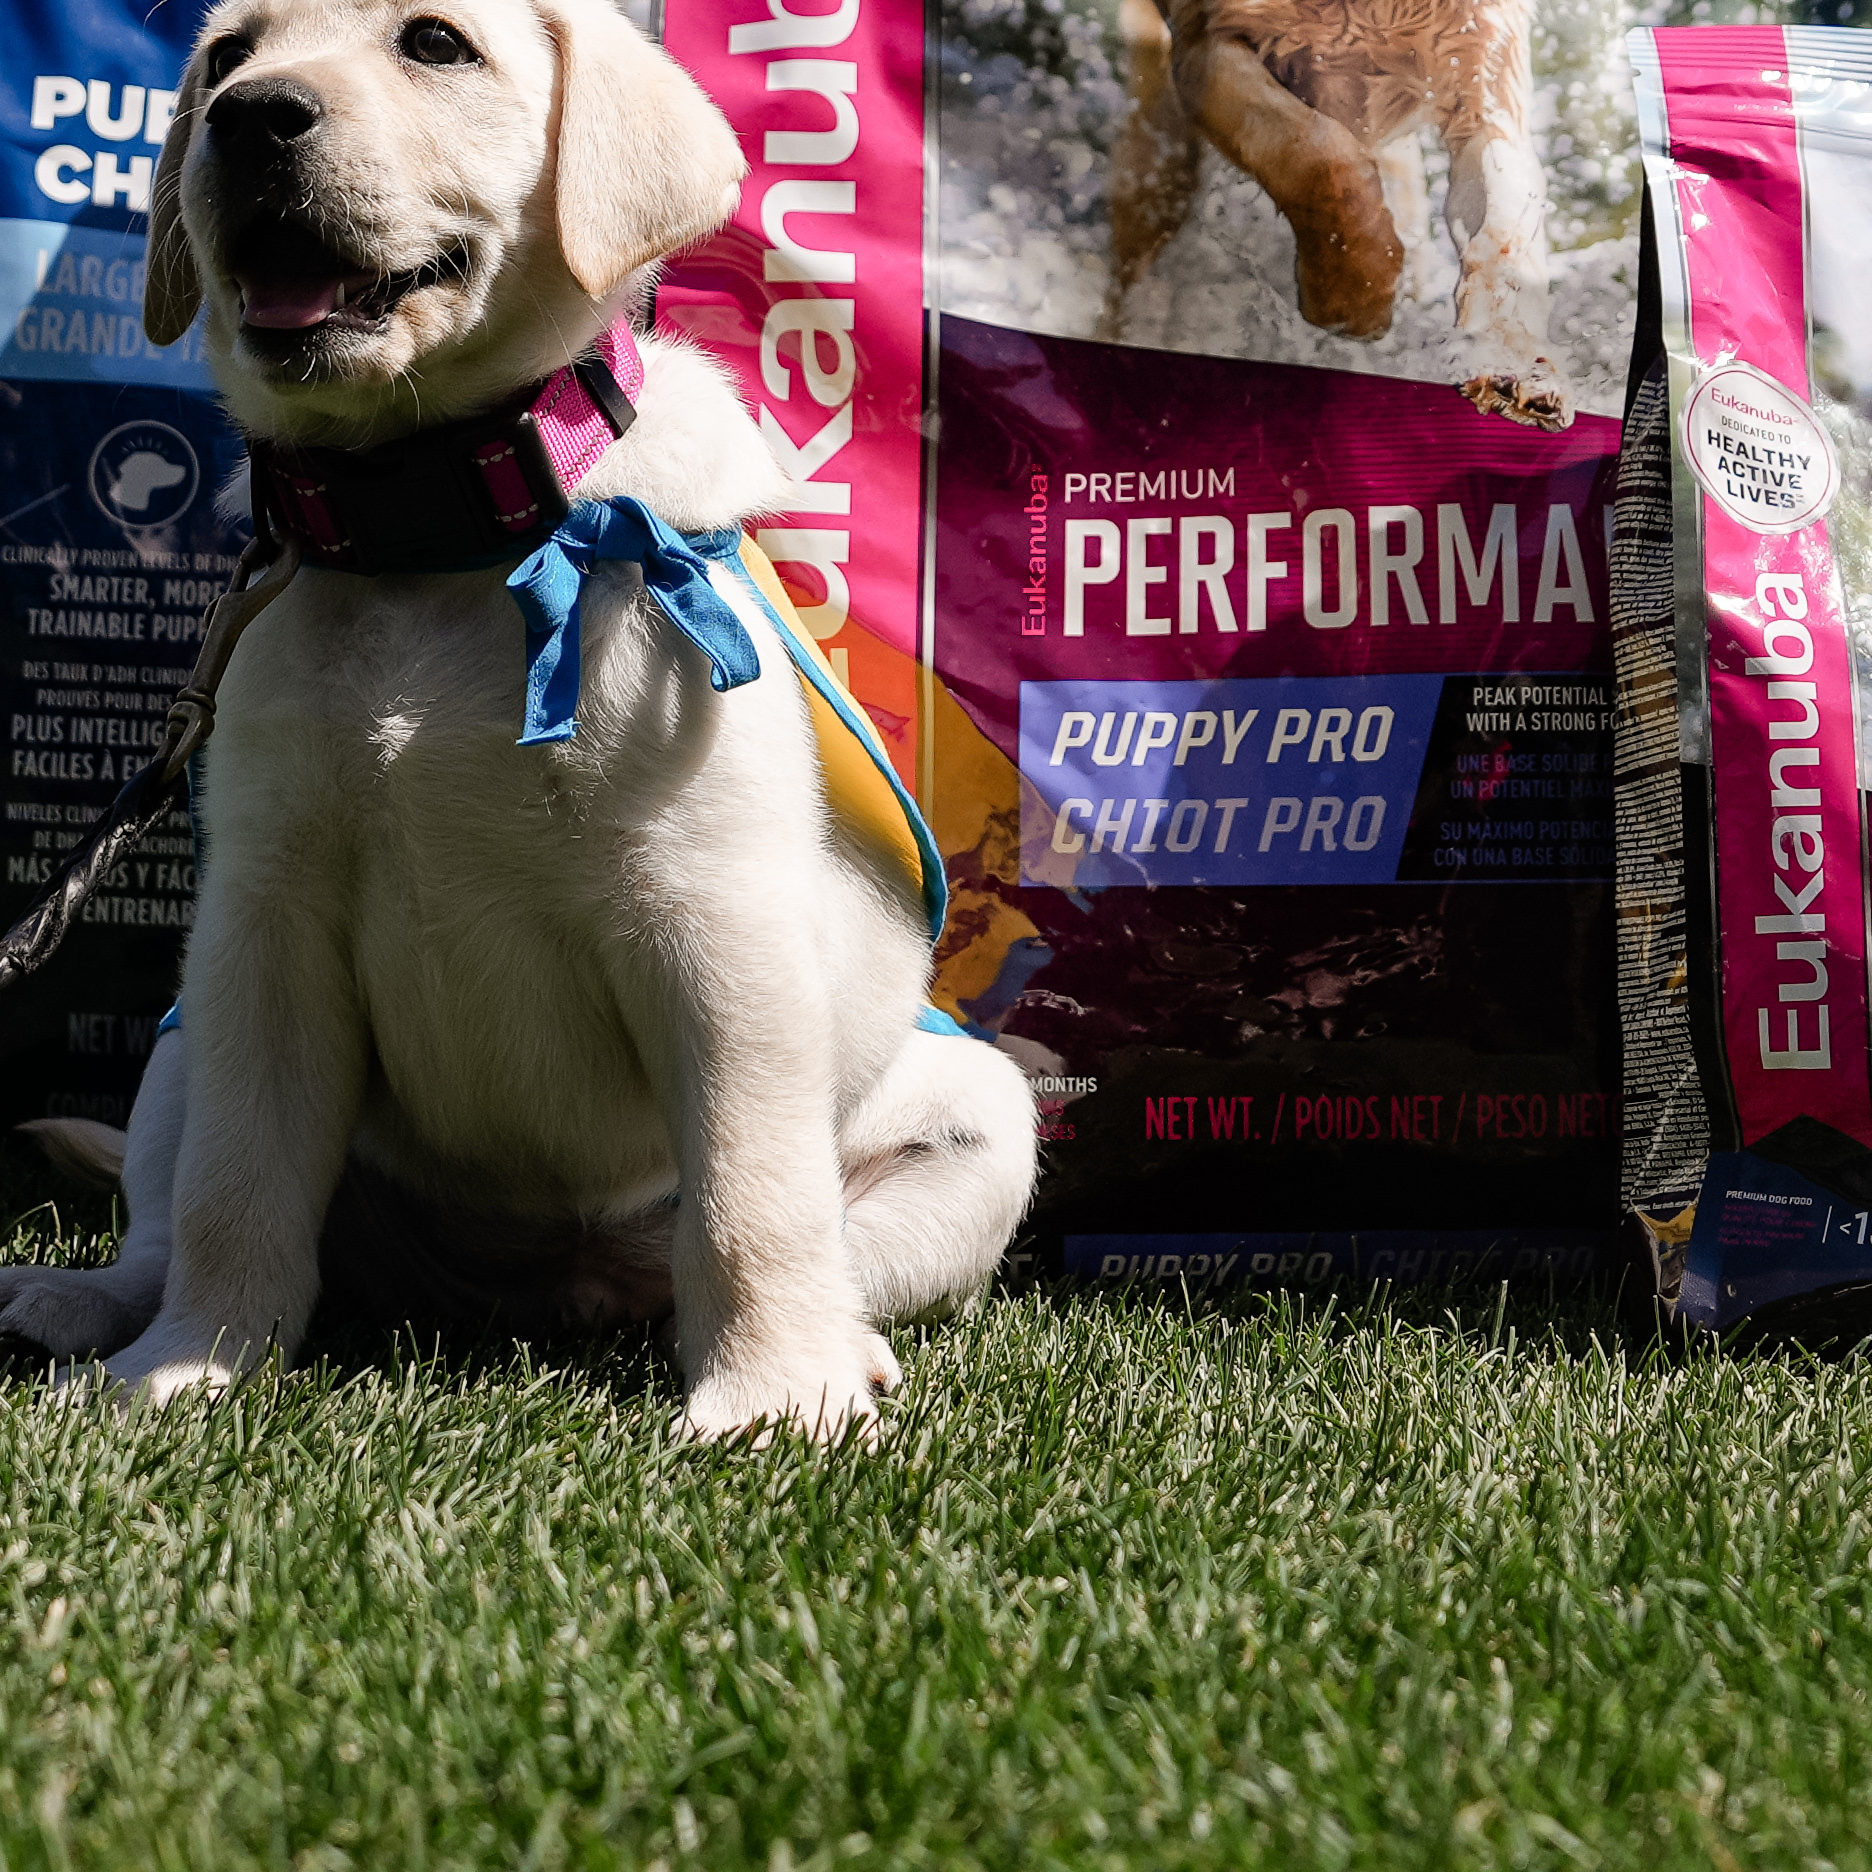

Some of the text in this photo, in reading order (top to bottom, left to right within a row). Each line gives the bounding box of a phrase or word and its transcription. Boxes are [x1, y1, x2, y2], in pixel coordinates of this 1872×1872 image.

[1711, 387, 1793, 425] Eukanuba
[1721, 415, 1792, 445] DEDICATED TO
[1707, 428, 1812, 471] HEALTHY
[1064, 466, 1236, 503] PREMIUM
[1717, 455, 1803, 490] ACTIVE
[1726, 478, 1797, 509] LIVES
[79, 548, 141, 569] PROVEN
[1021, 473, 1049, 637] Eukanuba
[1063, 503, 1614, 638] PERFORMA
[48, 573, 226, 609] SMARTER, MORE
[27, 607, 146, 641] TRAINABLE
[103, 689, 144, 712] POUR
[1472, 686, 1609, 707] PEAK POTENTIAL
[10, 713, 64, 744] PLUS
[1048, 705, 1395, 767] PUPPY PRO
[1465, 712, 1512, 732] WITH
[1514, 712, 1528, 732] A
[1530, 711, 1597, 732] STRONG
[11, 748, 95, 780] FACILES
[99, 747, 115, 781] À
[1455, 753, 1489, 774] UNE
[1493, 753, 1537, 773] BASE
[1541, 753, 1598, 774] SOLIDE
[1450, 779, 1474, 799] UN
[1477, 779, 1566, 799] POTENTIEL
[1049, 795, 1388, 855] CHIOT PRO
[1439, 821, 1462, 841] SU
[1746, 572, 1832, 1071] Eukanuba
[1432, 847, 1468, 867] CON
[1471, 847, 1508, 866] UNA
[1511, 846, 1556, 866] BASE
[67, 1012, 117, 1056] NET
[1146, 1095, 1199, 1141] NET
[1207, 1095, 1262, 1141] WT.
[1295, 1093, 1382, 1140] POIDS
[1390, 1093, 1445, 1140] NET
[1477, 1093, 1549, 1140] PESO
[1725, 1189, 1814, 1207] PREMIUM DOG FOOD
